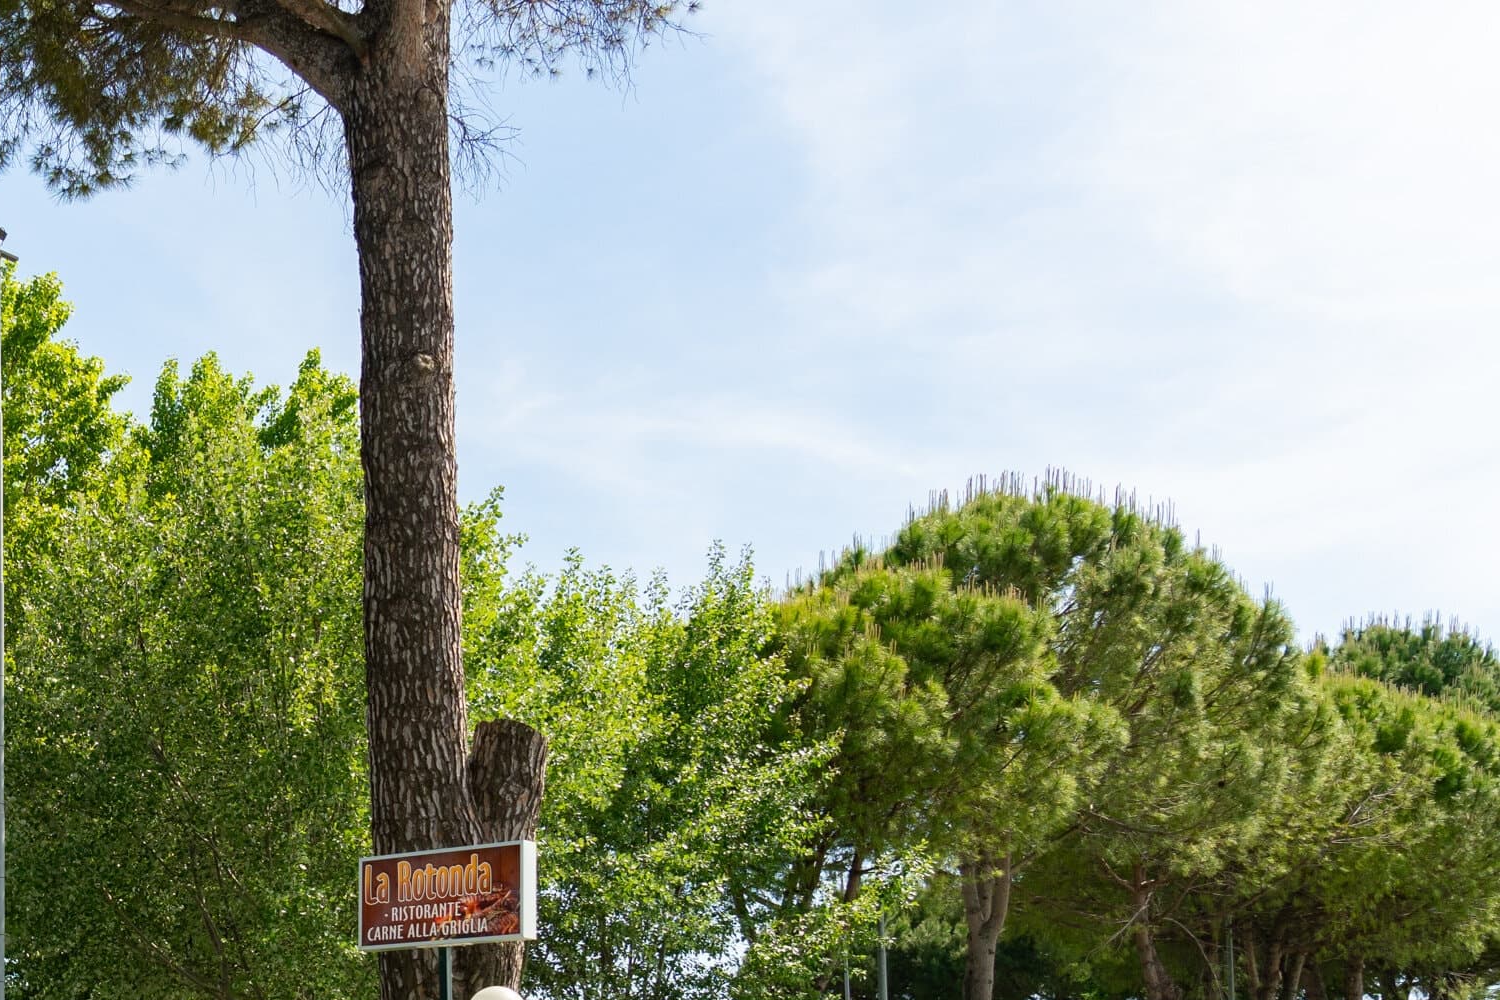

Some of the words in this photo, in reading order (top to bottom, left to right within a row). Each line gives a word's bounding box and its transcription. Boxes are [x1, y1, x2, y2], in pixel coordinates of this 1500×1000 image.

[364, 864, 390, 906] La
[397, 853, 492, 903] Rotonda
[391, 901, 462, 922] RISTORANTE
[367, 925, 404, 942] CARNE
[407, 922, 438, 939] ALLA
[441, 918, 488, 936] GRIGLIA
